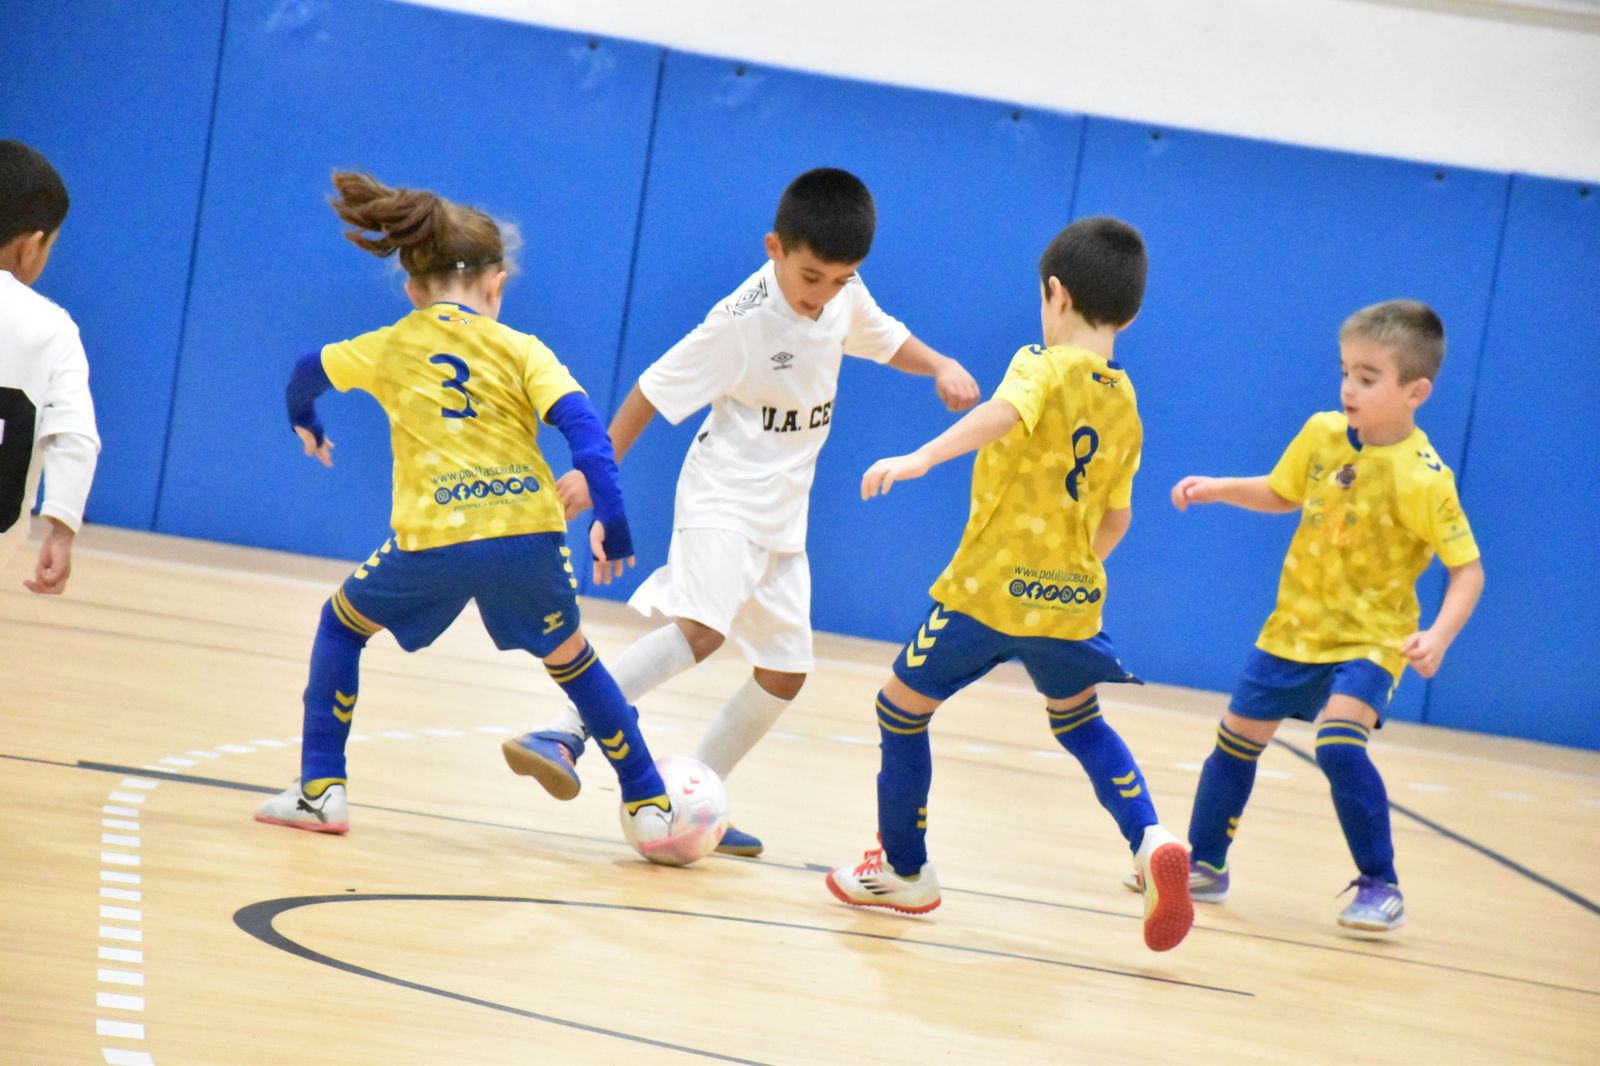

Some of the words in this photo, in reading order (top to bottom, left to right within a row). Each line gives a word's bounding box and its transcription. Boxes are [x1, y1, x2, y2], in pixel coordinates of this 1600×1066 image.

[429, 353, 478, 419] 3
[762, 406, 801, 432] U.A.
[809, 402, 831, 429] CE
[1065, 426, 1099, 502] 8
